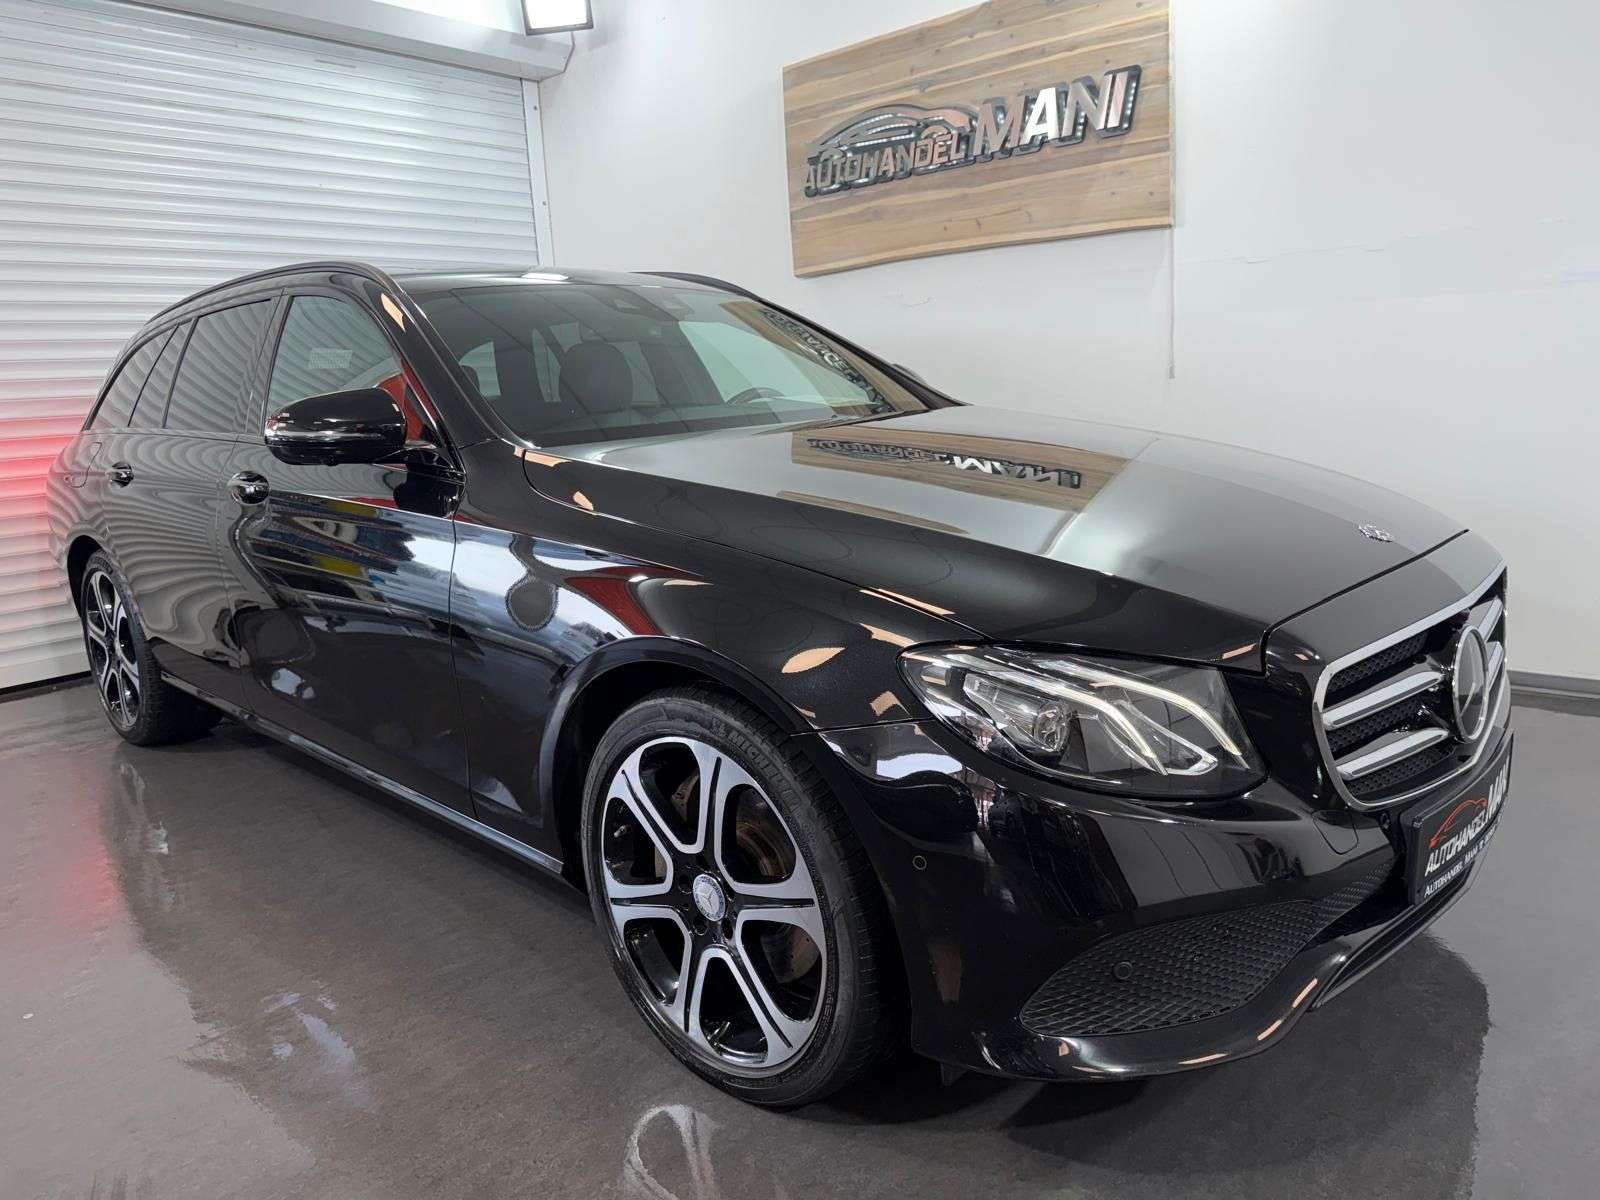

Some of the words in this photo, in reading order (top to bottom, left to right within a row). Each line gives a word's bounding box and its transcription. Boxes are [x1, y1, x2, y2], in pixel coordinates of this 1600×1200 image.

[804, 130, 968, 192] AUTOHANDEL
[973, 66, 1137, 160] MANI
[1424, 808, 1489, 877] AUTOHANDEL
[1487, 755, 1510, 820] MAN
